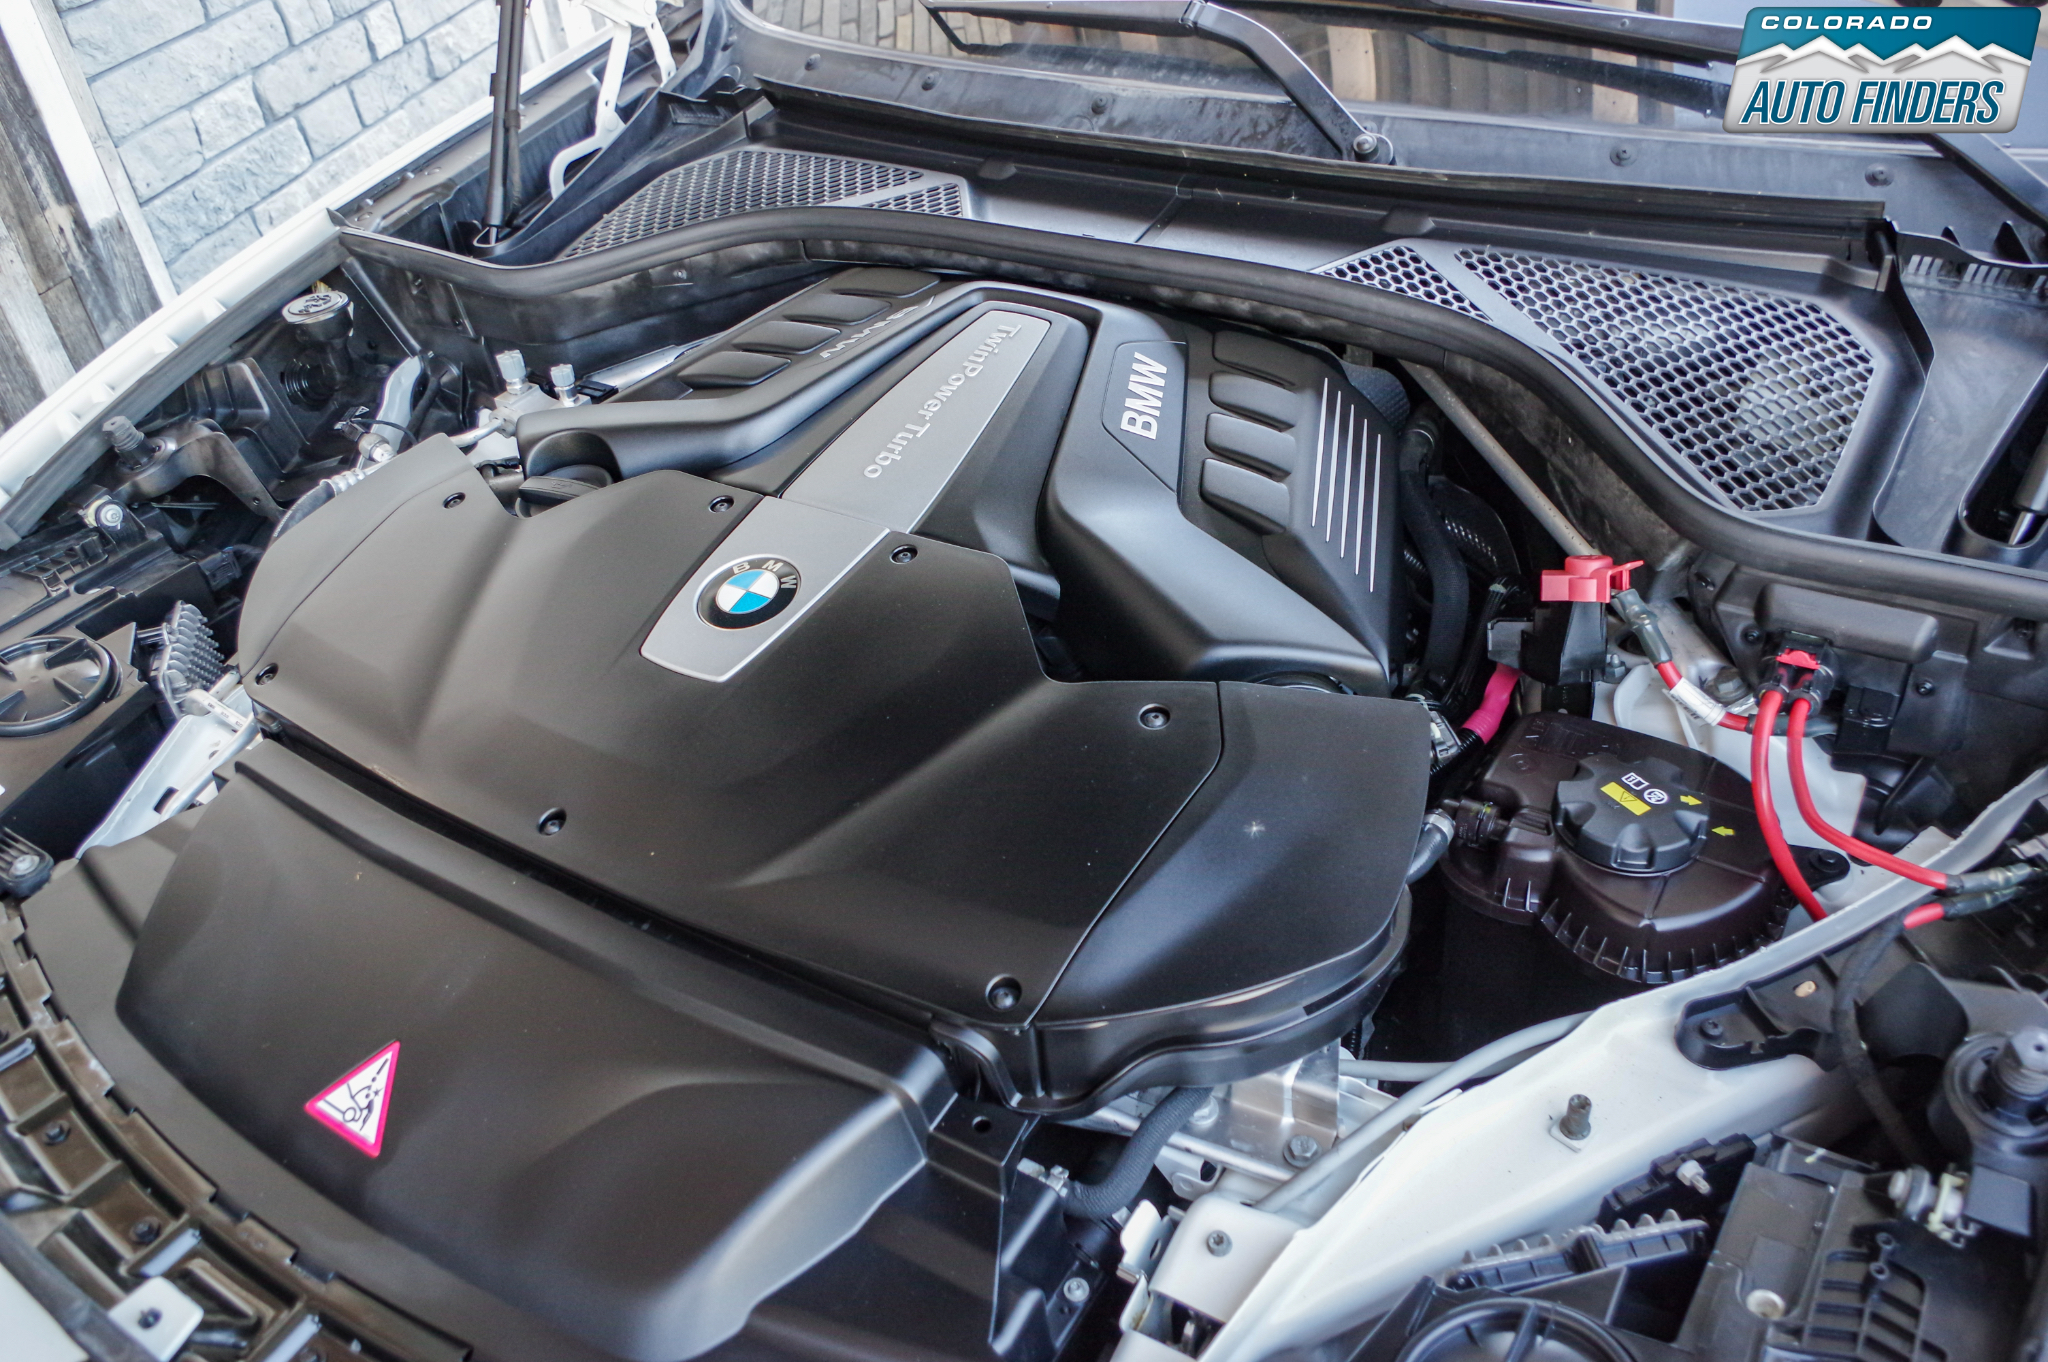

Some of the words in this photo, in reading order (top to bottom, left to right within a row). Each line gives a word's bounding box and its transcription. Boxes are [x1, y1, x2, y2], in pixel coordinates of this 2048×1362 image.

[917, 324, 1022, 421] TwinPower
[1120, 351, 1168, 441] BMW
[863, 422, 931, 478] Turbo
[732, 559, 798, 589] BMW
